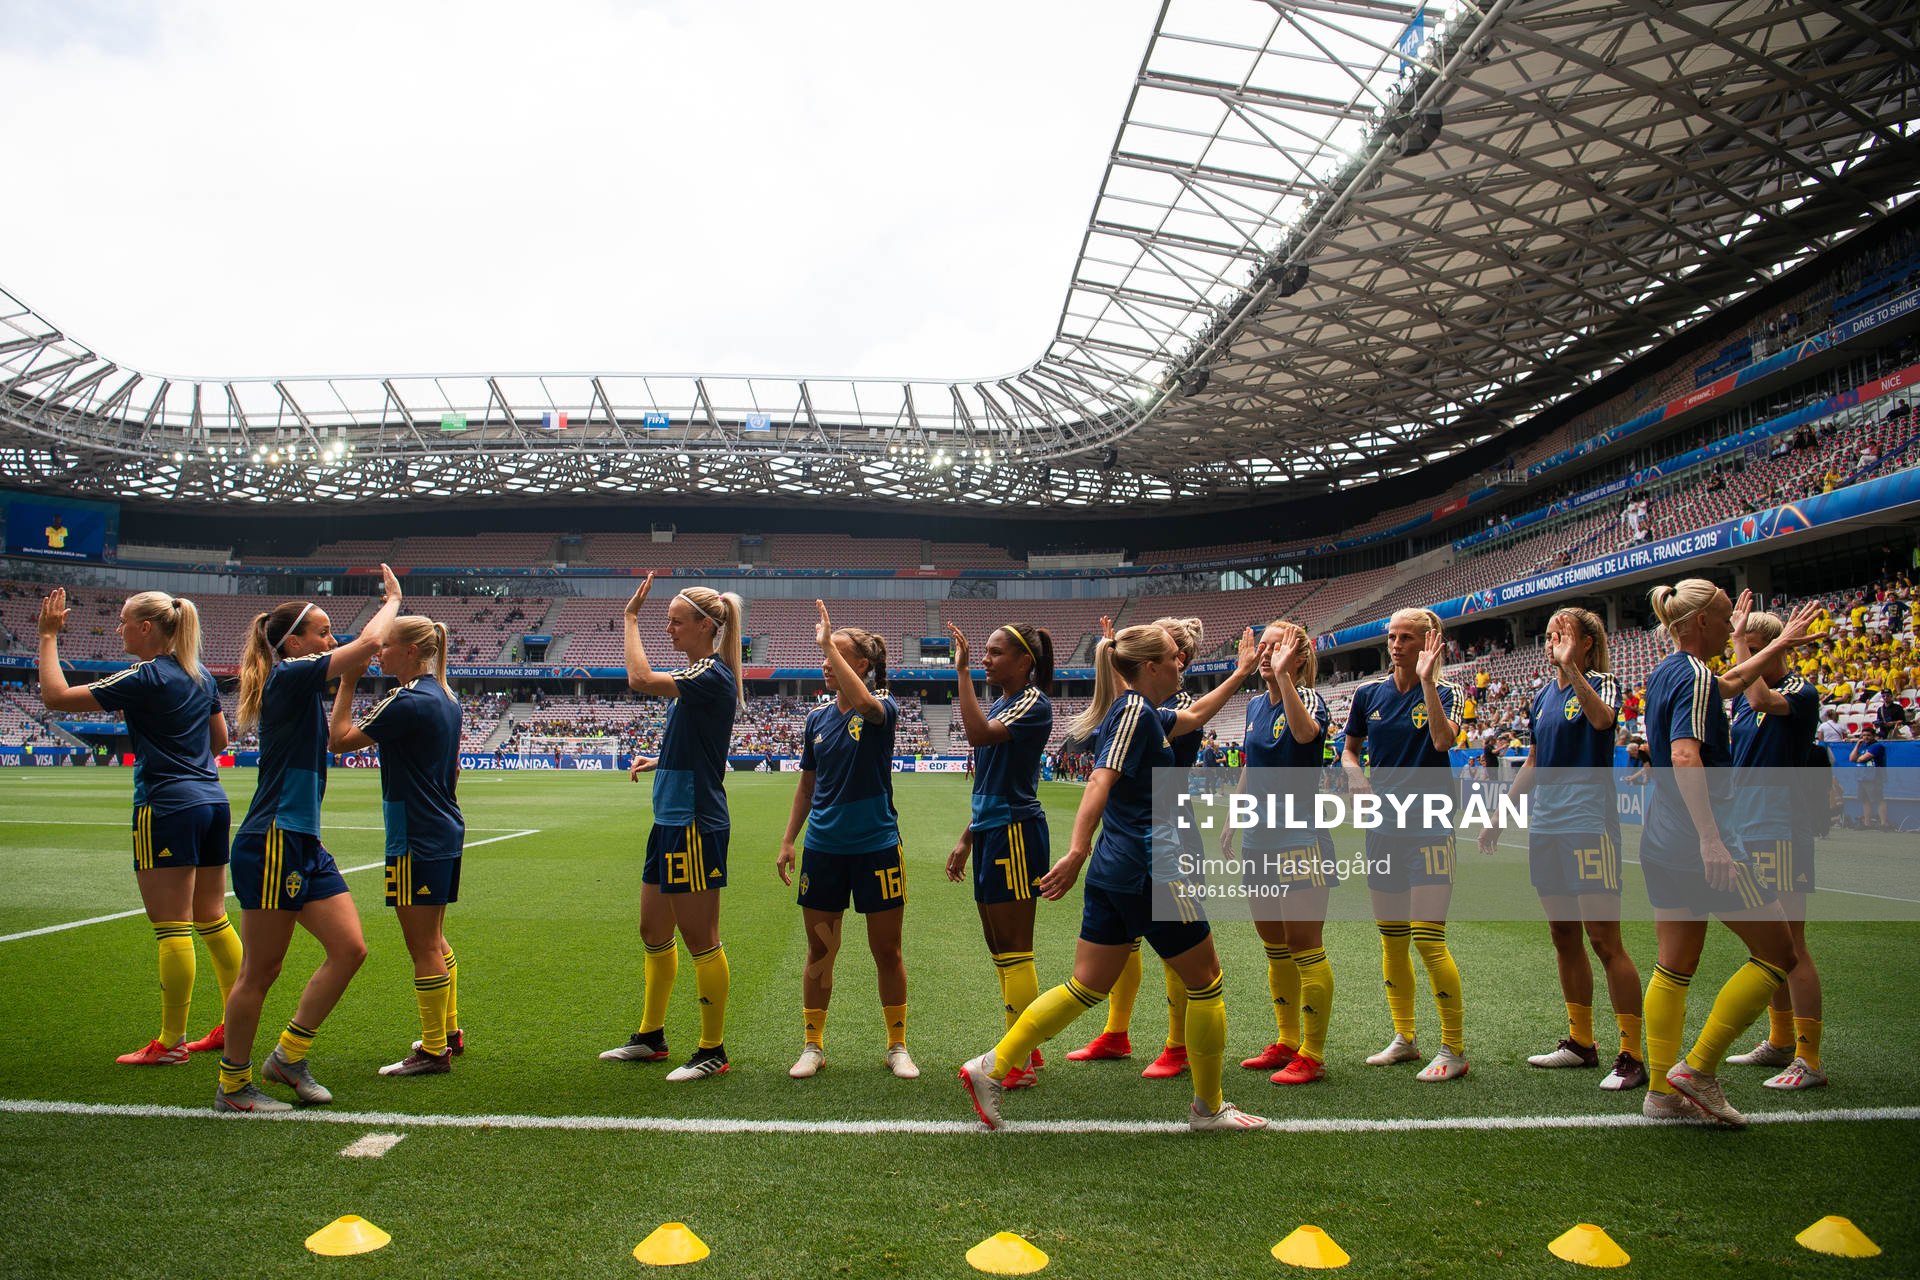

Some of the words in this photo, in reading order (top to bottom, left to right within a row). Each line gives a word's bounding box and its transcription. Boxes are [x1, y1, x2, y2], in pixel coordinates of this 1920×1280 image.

[1853, 314, 1876, 332] DARE
[1876, 308, 1889, 321] TO
[1889, 295, 1918, 316] SHINE
[1881, 375, 1902, 391] NICE
[647, 416, 666, 424] FIFA
[1501, 583, 1525, 600] COUPE
[1525, 581, 1535, 594] DU
[1536, 576, 1564, 592] MONDE
[1564, 562, 1604, 584] FÉMININE
[1604, 559, 1617, 574] DE
[1617, 555, 1630, 571] LA
[1630, 550, 1653, 567] FIFA,
[1653, 540, 1693, 562] FRANCE
[479, 668, 494, 676] CUP
[495, 668, 523, 676] FRANCE
[1191, 664, 1205, 672] DARE
[1214, 662, 1228, 670] SHINE
[0, 754, 20, 766] VISA
[34, 754, 53, 766] VISA
[574, 759, 603, 769] VISA
[665, 852, 689, 884] 13
[1419, 845, 1449, 875] 10
[1573, 849, 1603, 880] 15
[874, 866, 903, 900] 16
[994, 858, 1013, 890] 7
